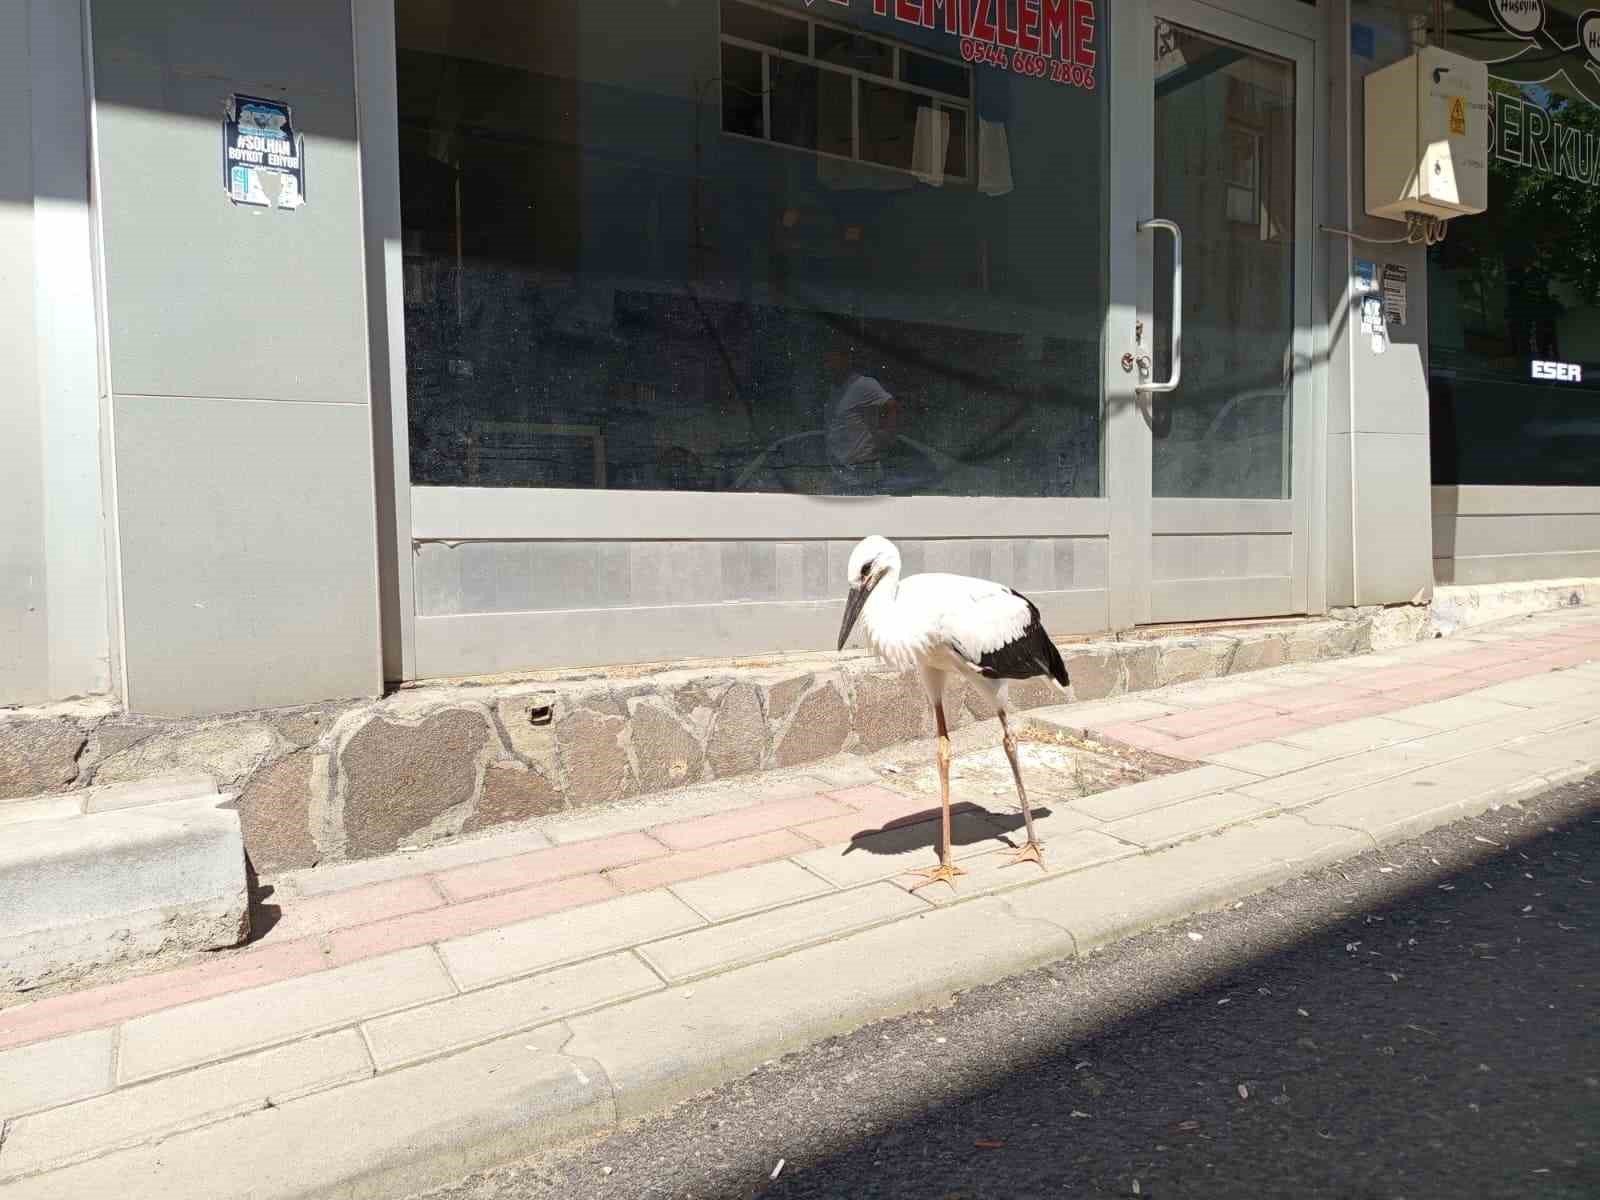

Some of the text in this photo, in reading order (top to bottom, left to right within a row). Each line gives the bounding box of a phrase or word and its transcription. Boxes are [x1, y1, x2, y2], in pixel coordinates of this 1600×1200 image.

[960, 38, 1096, 90] 0544 669 2806
[229, 146, 264, 164] BOYKOT
[1531, 360, 1582, 382] ESER
